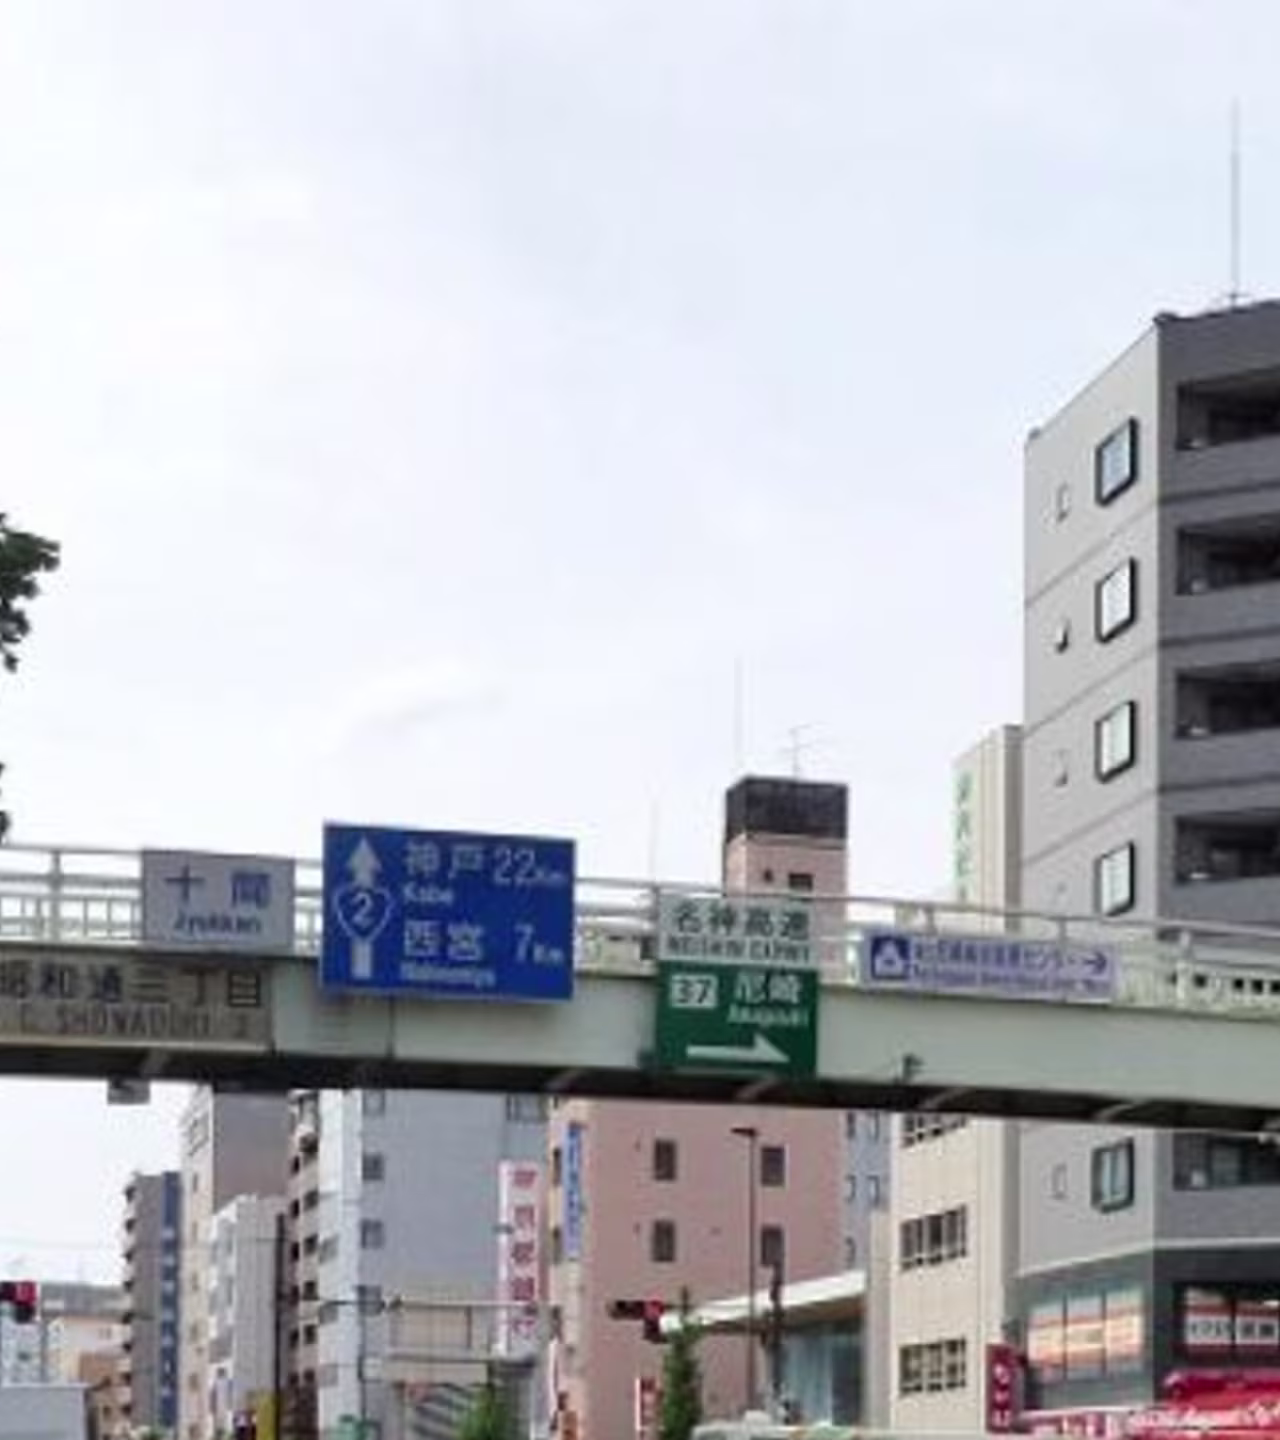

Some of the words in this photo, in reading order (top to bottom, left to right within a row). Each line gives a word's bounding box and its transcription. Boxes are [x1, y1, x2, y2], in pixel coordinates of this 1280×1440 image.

[404, 841, 483, 880] 神戸
[351, 893, 373, 928] 2
[403, 920, 485, 961] 西宮
